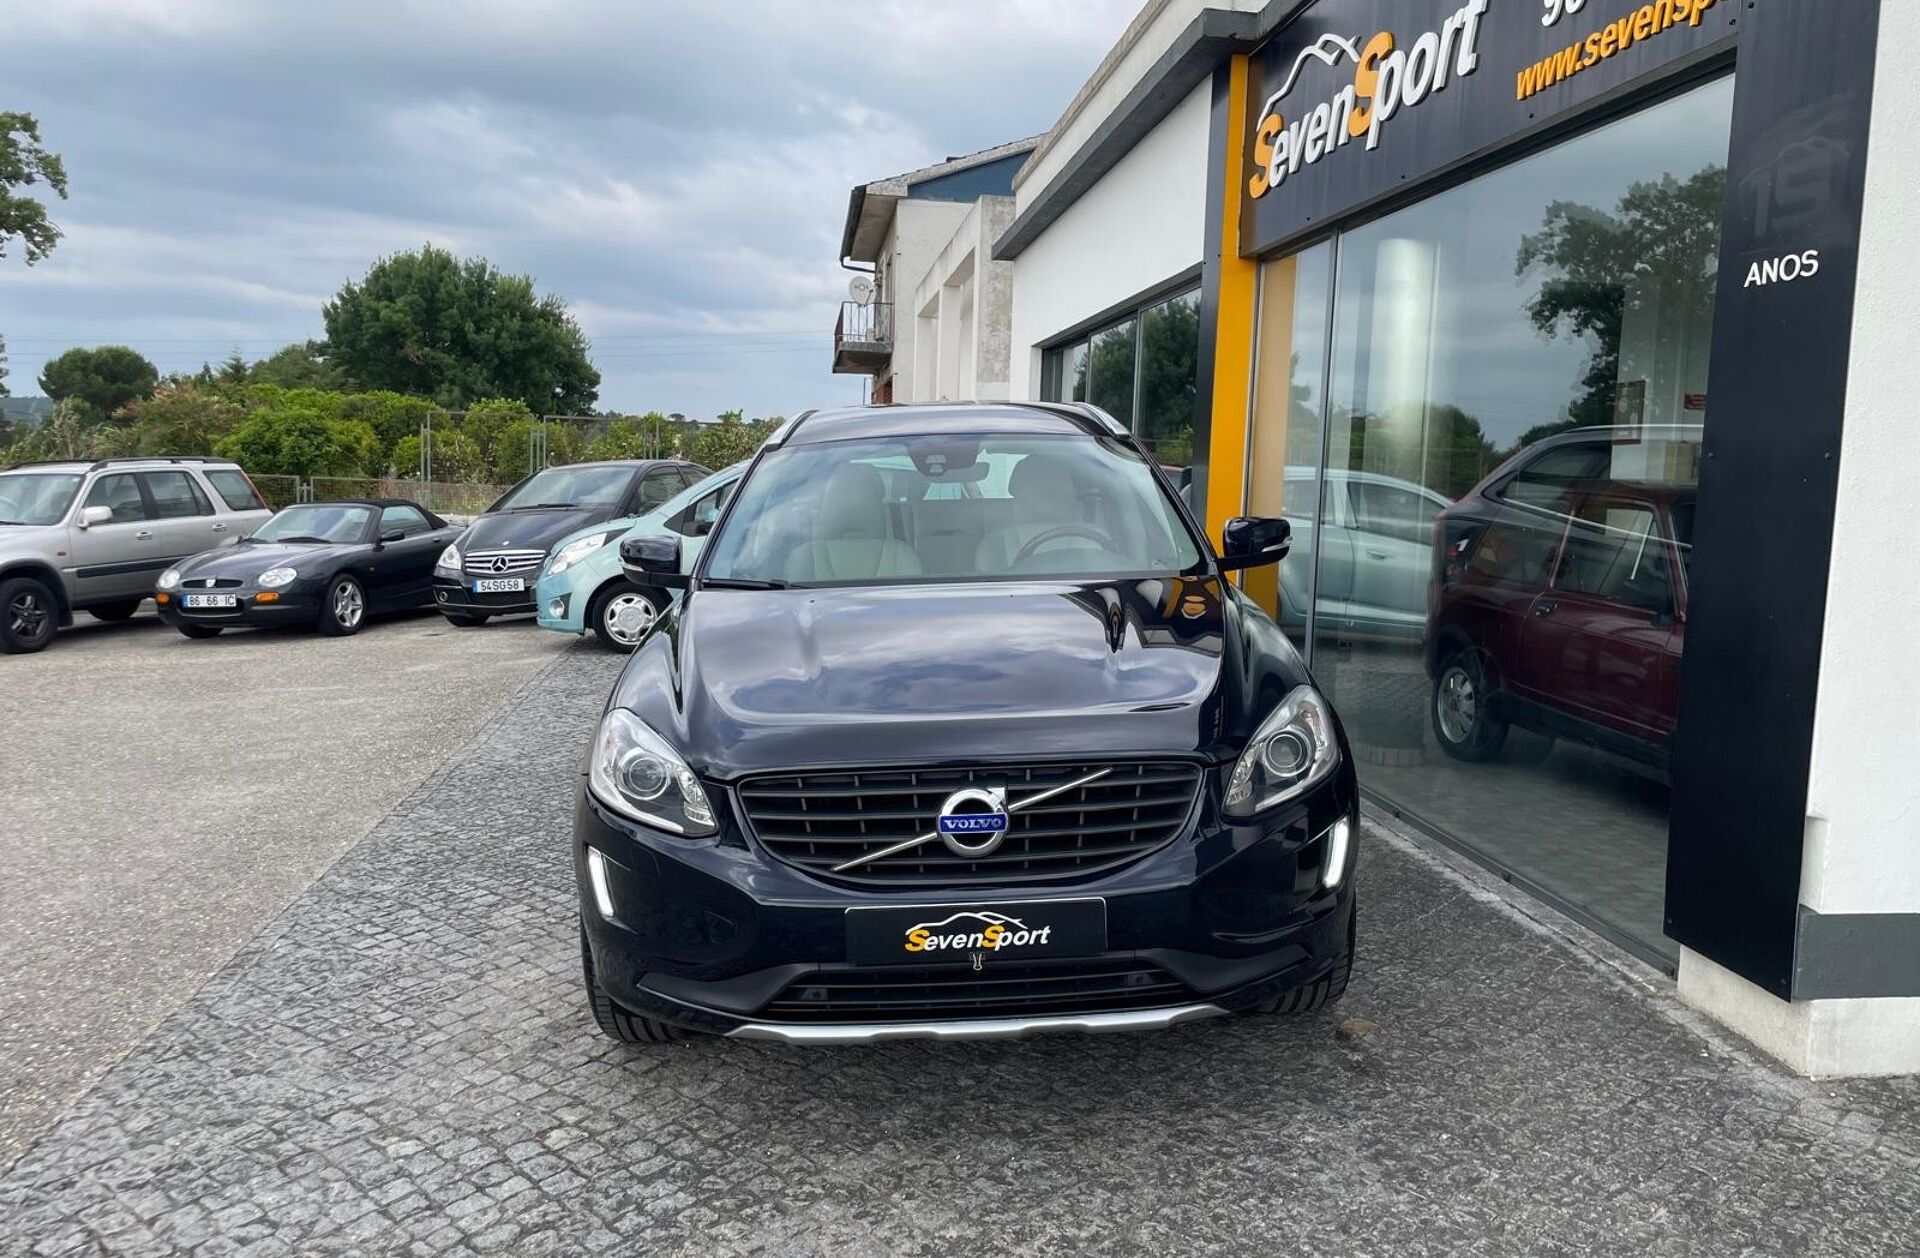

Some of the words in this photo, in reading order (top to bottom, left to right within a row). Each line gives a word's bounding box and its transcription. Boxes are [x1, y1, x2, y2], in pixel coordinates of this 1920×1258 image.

[1249, 0, 1488, 199] SevenSport
[1743, 249, 1819, 288] ANOS
[943, 818, 1003, 829] VOLVO
[904, 924, 1051, 952] SevenSport
